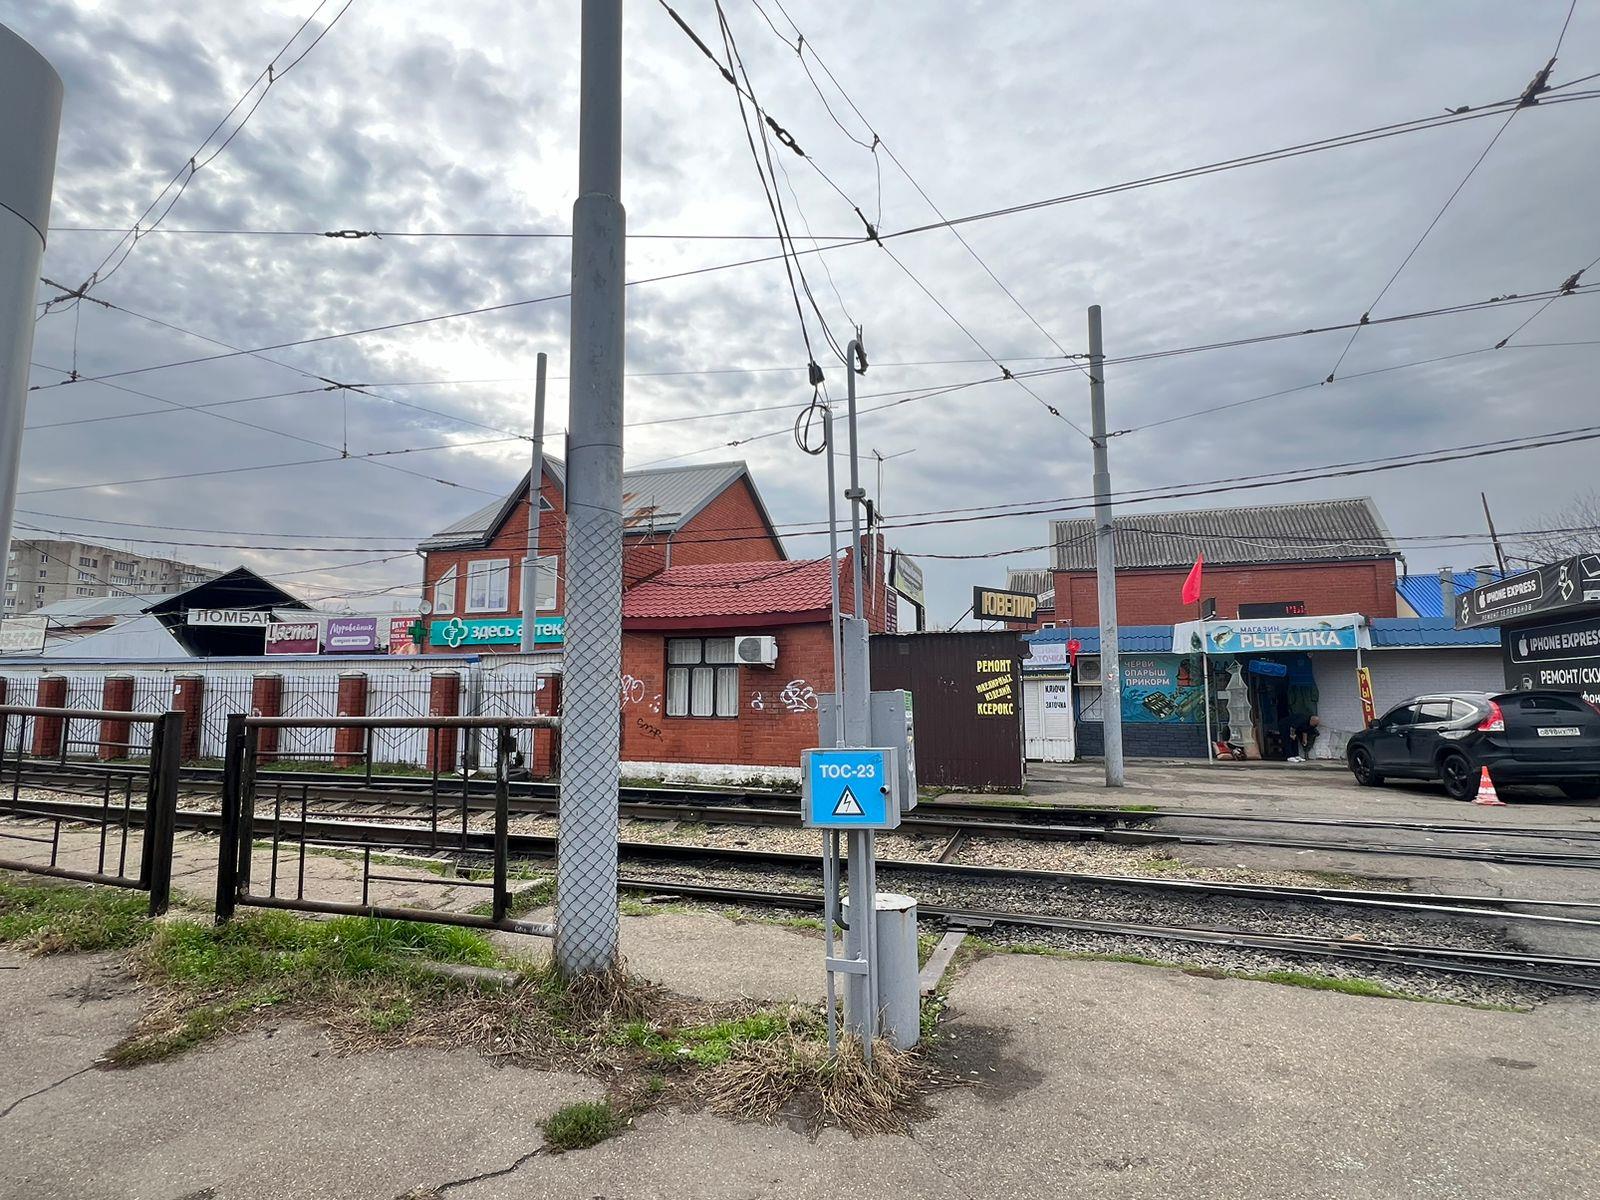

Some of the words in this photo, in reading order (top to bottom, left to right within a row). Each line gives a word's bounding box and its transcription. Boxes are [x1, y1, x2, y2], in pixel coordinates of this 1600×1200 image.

[1486, 590, 1507, 604] IPHONE
[1507, 580, 1537, 598] EXPRESS
[982, 591, 1037, 618] ЮВЕЛИР
[266, 623, 318, 643] Цветы
[471, 625, 515, 639] здесь
[1240, 625, 1280, 633] МАГАЗИН
[1240, 631, 1341, 649] РЫБАЛКА
[1530, 635, 1561, 652] IPHONE
[976, 660, 1011, 673] РЕМОНТ
[1124, 660, 1154, 668] ЧЕРВИ
[1124, 669, 1166, 677] ОПАРЫШ
[1125, 678, 1170, 686] ПРИКОРМ
[1045, 685, 1066, 693] КЛЮЧИ
[977, 703, 1014, 715] КСЕРОКС
[1045, 701, 1067, 709] ЗАТОЧКА
[819, 764, 876, 779] ТОС-23
